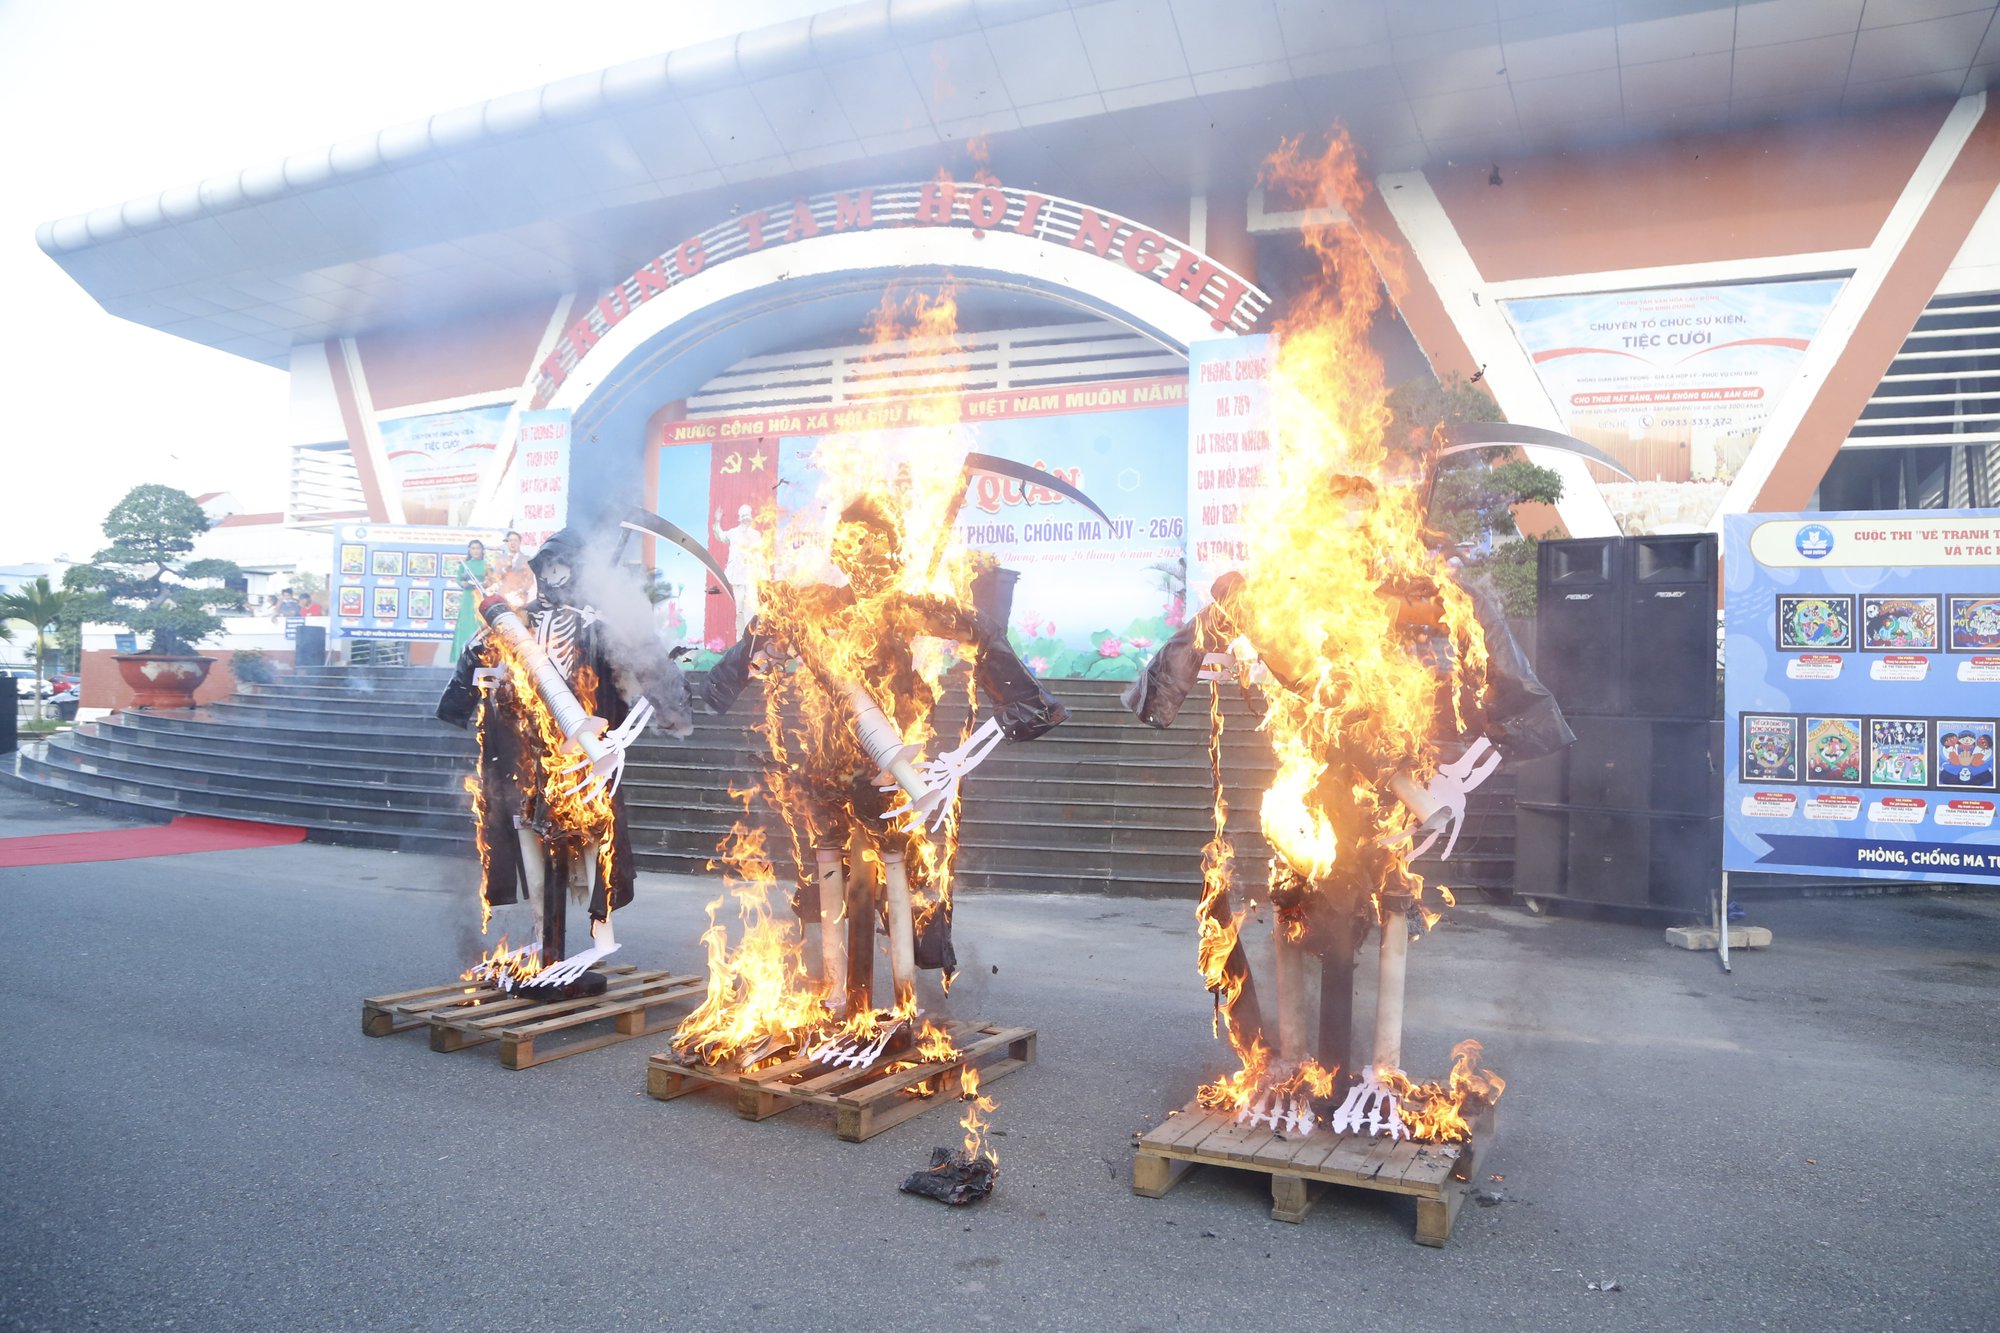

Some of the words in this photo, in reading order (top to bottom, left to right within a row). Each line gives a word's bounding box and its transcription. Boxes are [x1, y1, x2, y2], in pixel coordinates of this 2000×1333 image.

[540, 237, 709, 390] TRUNG
[739, 187, 874, 251] TÂM
[915, 176, 1047, 238] HỘI
[1069, 207, 1248, 332] NGHỊ
[1590, 320, 1638, 331] CHUYÊN
[1642, 318, 1657, 329] TỔ
[1660, 316, 1693, 328] CHỨC
[1695, 315, 1711, 327] SỰ
[1622, 334, 1662, 350] TIỆC
[1667, 331, 1713, 346] CƯỚI
[1216, 396, 1230, 417] MA
[1573, 396, 1591, 405] CHO
[1672, 390, 1700, 400] KHÔNG
[674, 423, 717, 441] NƯỚC
[720, 420, 764, 438] CỘNG
[768, 416, 802, 432] HÒA
[807, 412, 829, 430] XÃ
[969, 398, 1007, 417] VIỆT
[1013, 395, 1060, 412] NAM
[1065, 390, 1127, 410] MUÔN
[967, 520, 1019, 545] PHÒNG,
[1024, 516, 1075, 542] CHỐNG
[1078, 521, 1102, 541] MA
[1149, 518, 1184, 538] 26/6
[1854, 530, 1886, 543] CUỘC
[1890, 531, 1913, 541] THI
[1942, 529, 1990, 540] TRANH
[1944, 544, 1962, 556] VÀ
[1966, 544, 1992, 556] TÁC
[1858, 846, 1908, 866] PHÒNG,
[1911, 847, 1960, 866] CHỐNG
[1963, 854, 1985, 868] MA
